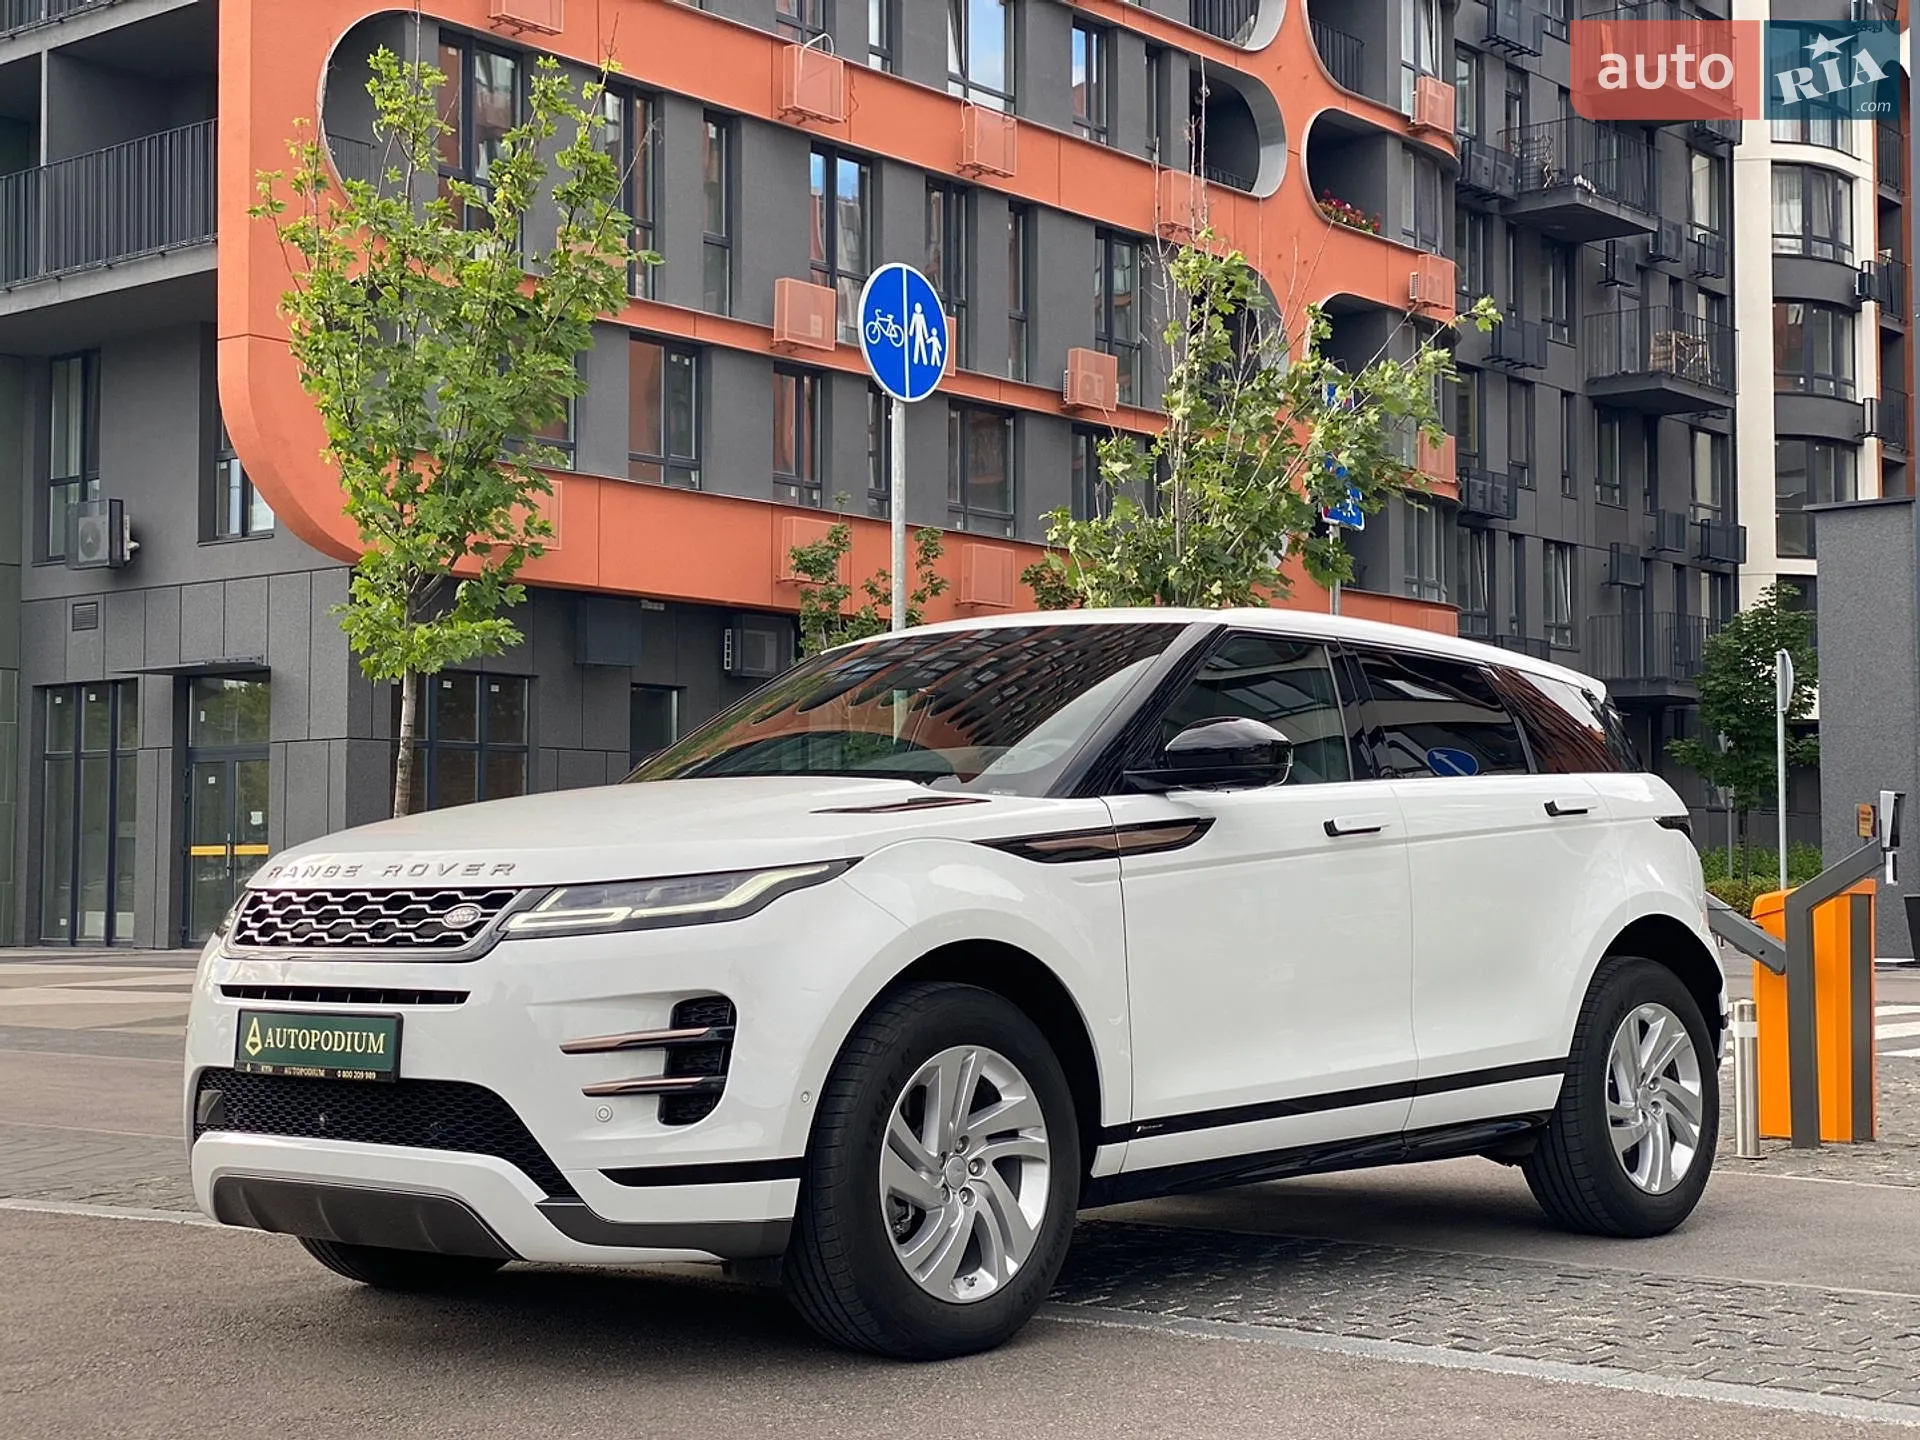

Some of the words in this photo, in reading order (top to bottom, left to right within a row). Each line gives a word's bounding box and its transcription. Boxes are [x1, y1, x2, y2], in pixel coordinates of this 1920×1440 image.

[267, 864, 362, 879] RANGE
[381, 862, 516, 879] ROVER
[264, 1027, 386, 1055] AUTOPODIUM
